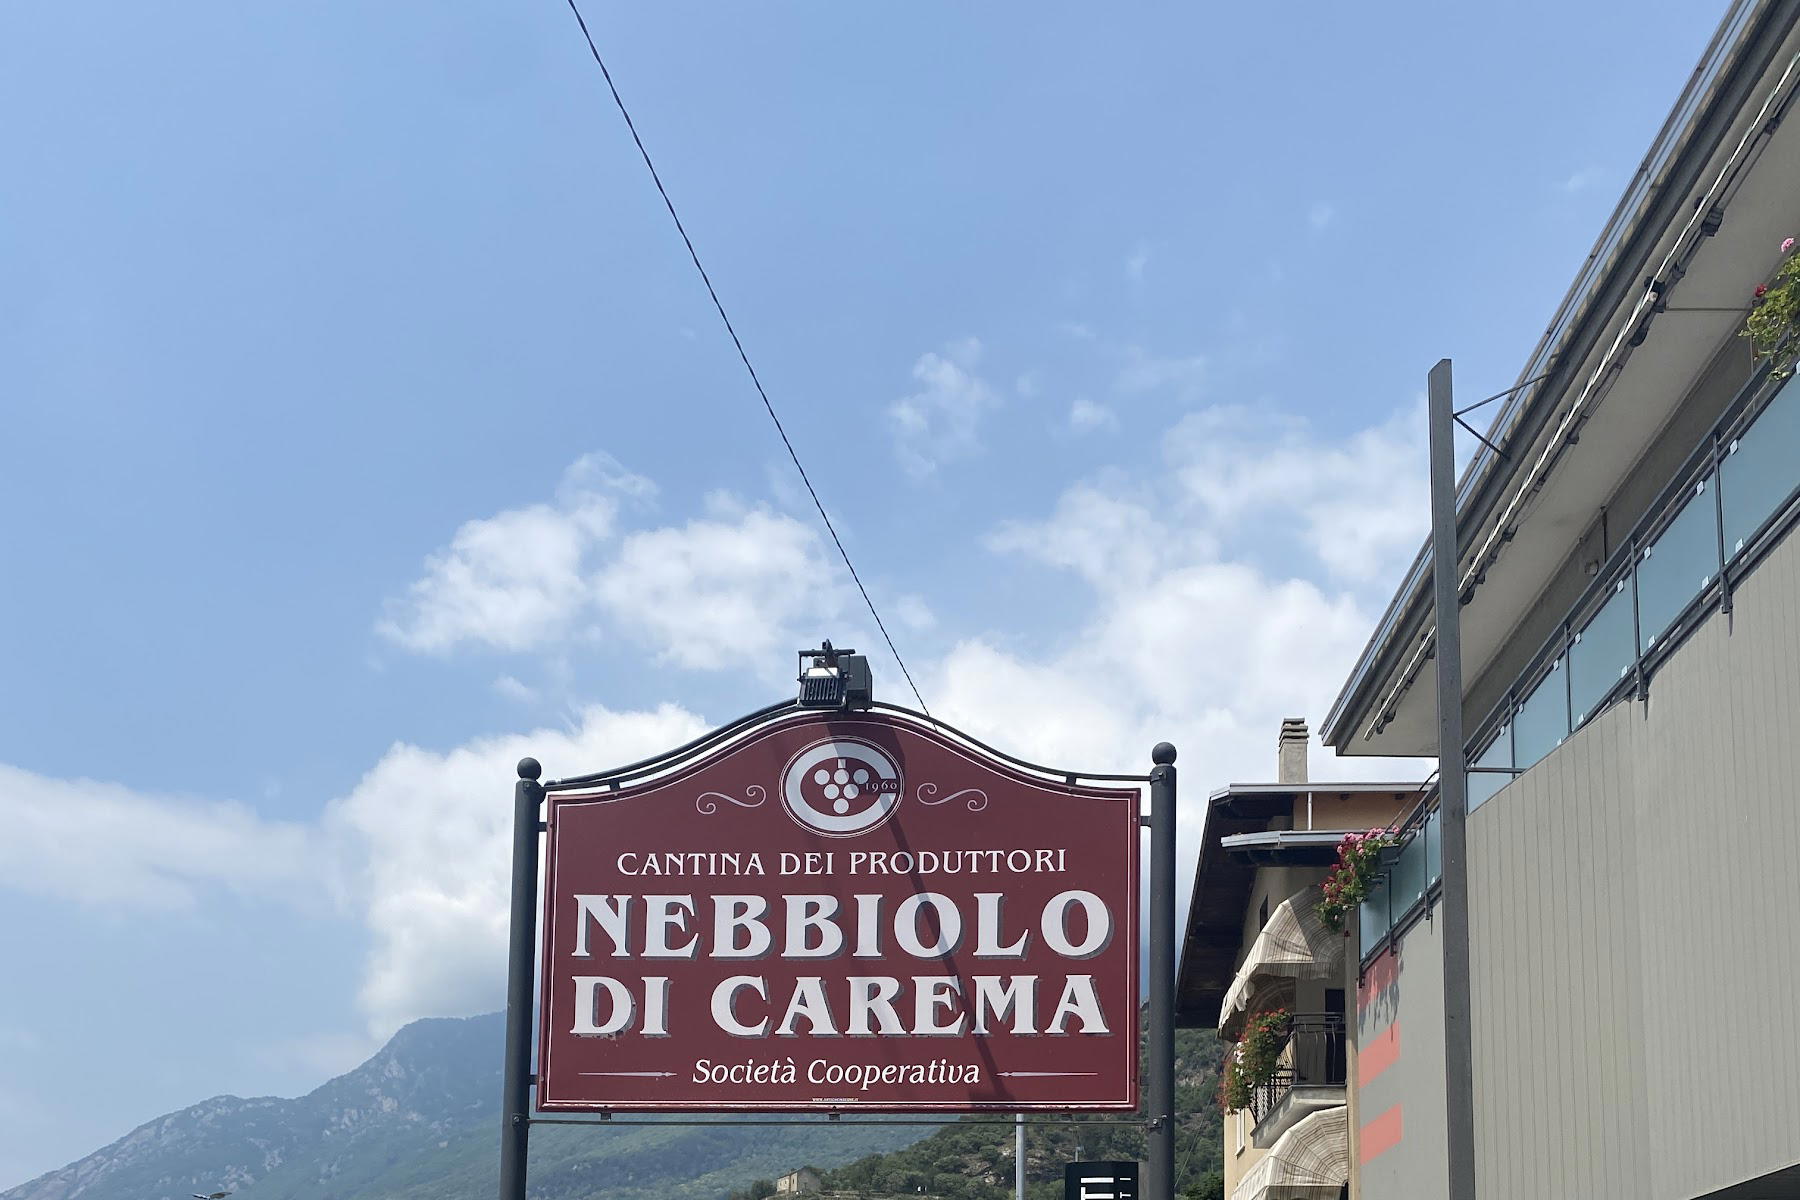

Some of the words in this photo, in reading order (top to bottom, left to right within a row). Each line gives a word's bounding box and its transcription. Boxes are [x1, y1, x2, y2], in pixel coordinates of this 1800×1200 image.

[865, 780, 898, 793] 1960
[617, 852, 766, 877] CANTINA
[779, 851, 834, 875] DEI
[849, 848, 1066, 875] PRODUTTORI
[572, 889, 1114, 960] NEBBIOLO
[570, 975, 673, 1037] DI
[710, 974, 1112, 1037] CAREMA
[692, 1057, 796, 1084] Società
[807, 1057, 980, 1091] Cooperativa
